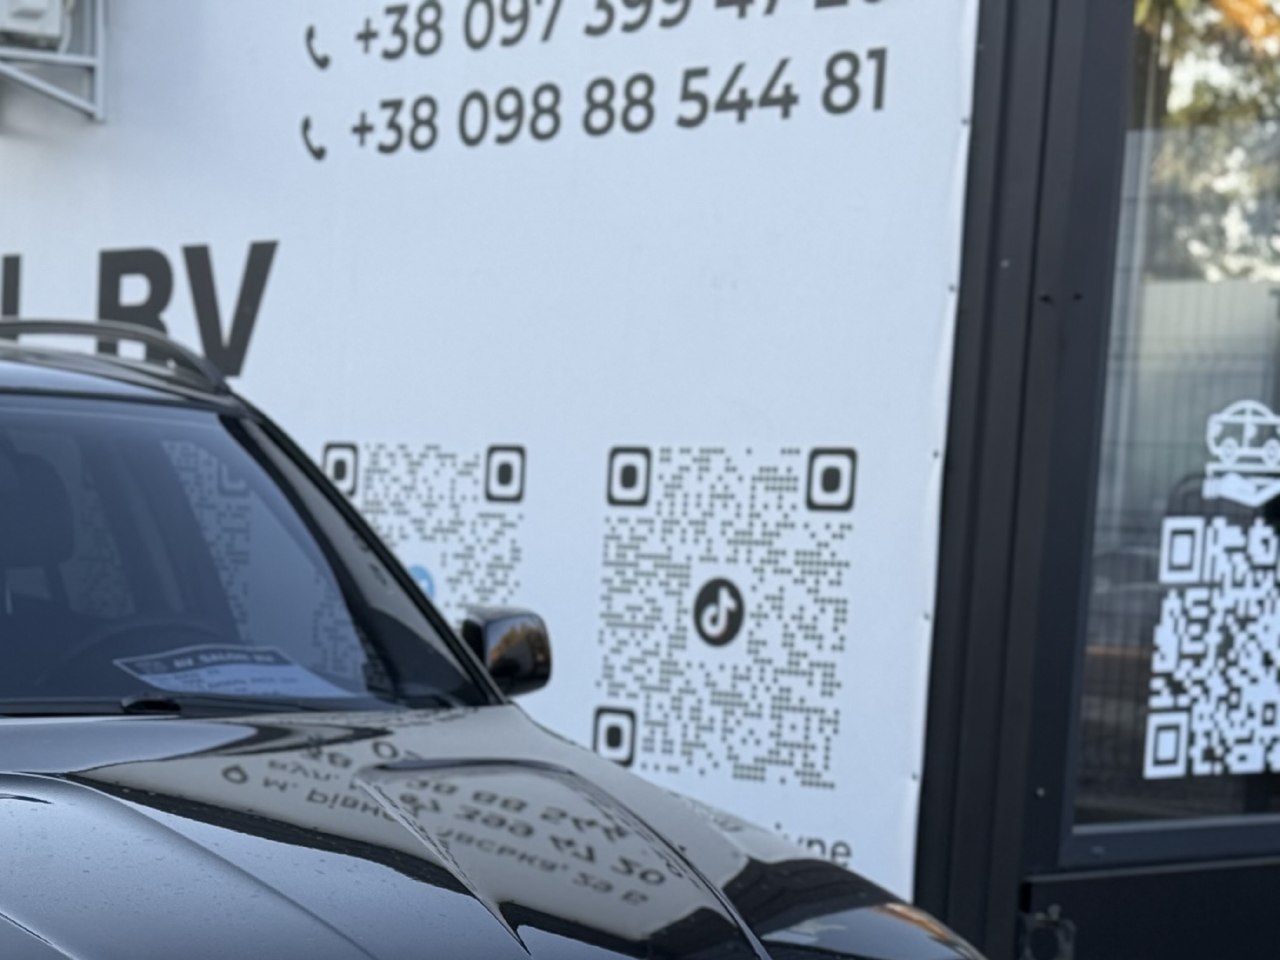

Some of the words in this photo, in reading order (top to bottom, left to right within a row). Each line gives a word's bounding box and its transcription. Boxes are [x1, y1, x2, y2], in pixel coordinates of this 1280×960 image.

[355, 0, 444, 61] +38
[351, 96, 439, 154] +38
[458, 83, 562, 147] 098
[582, 73, 656, 136] 88
[676, 58, 799, 128] 544
[821, 47, 888, 115] 81
[97, 240, 279, 377] RV
